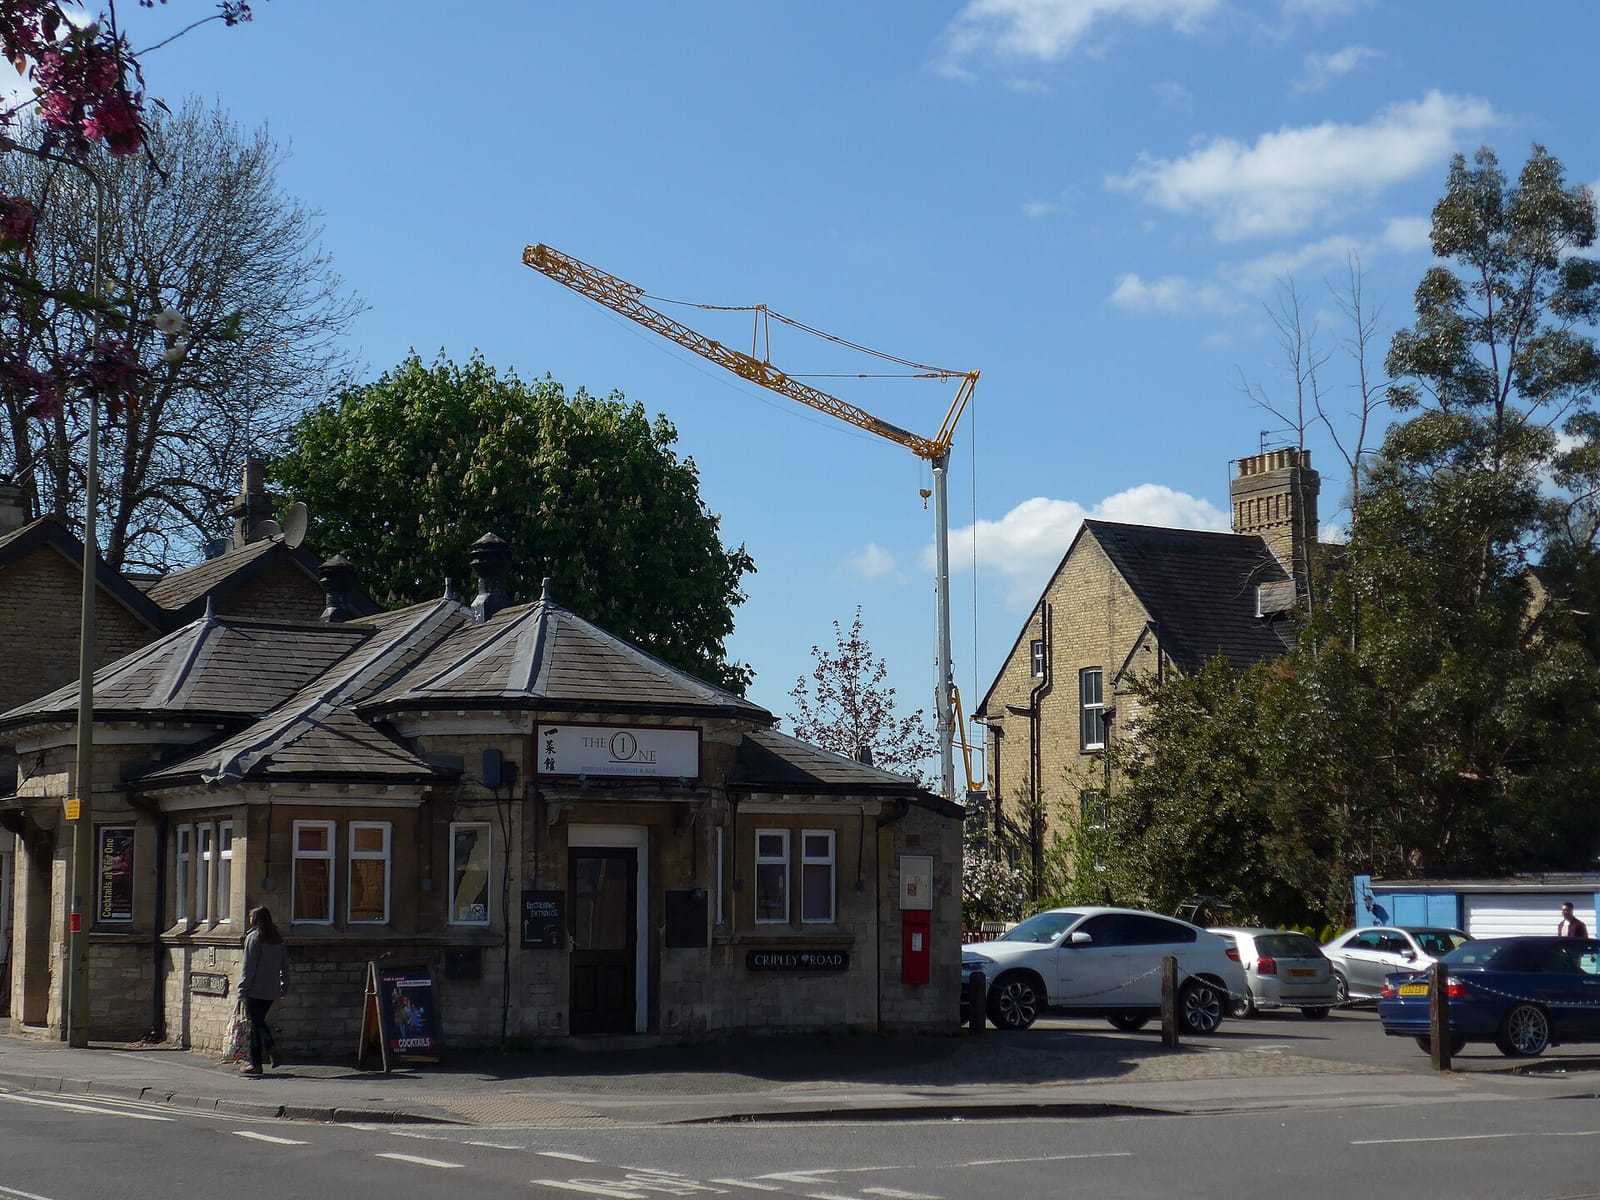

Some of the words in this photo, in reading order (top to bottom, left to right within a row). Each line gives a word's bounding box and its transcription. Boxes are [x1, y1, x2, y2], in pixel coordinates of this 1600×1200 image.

[583, 737, 606, 749] THE
[103, 838, 115, 854] One
[102, 881, 113, 918] Cocktails
[754, 954, 800, 966] CRIPLEY
[810, 954, 842, 966] ROAD
[398, 1037, 430, 1048] COCKTAILS
